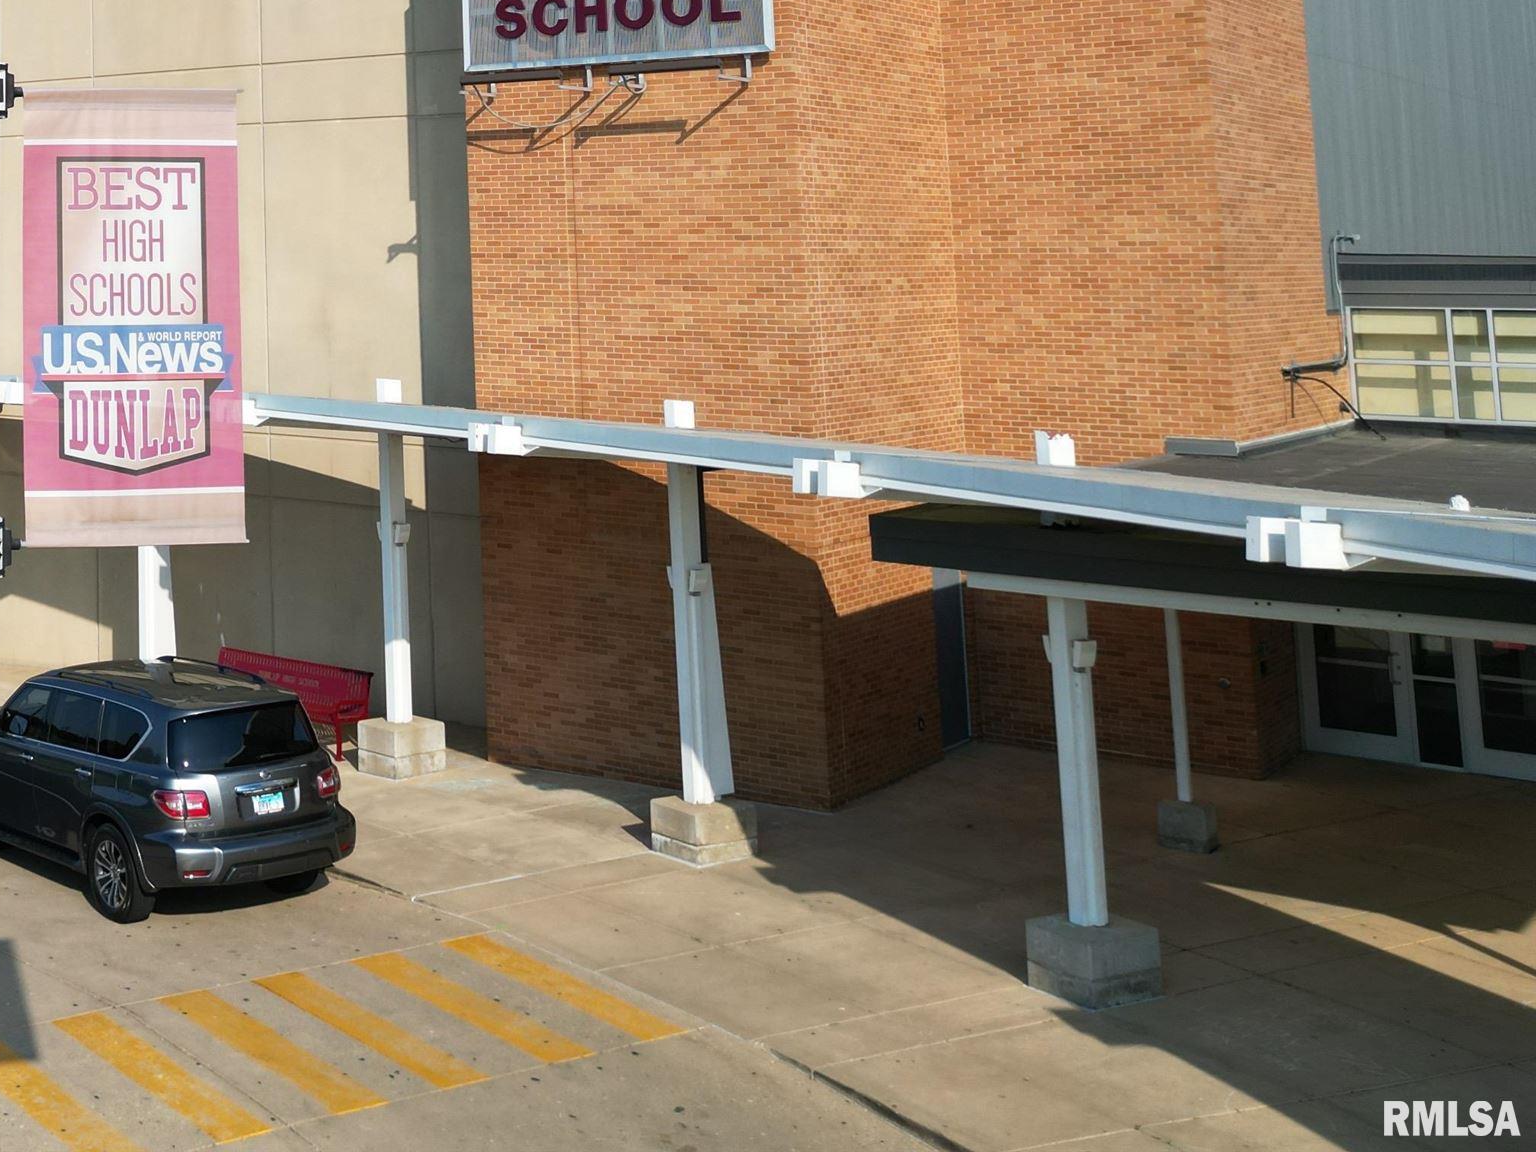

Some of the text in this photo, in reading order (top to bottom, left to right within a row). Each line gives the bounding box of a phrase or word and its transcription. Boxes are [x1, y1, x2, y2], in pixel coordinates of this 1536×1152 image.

[67, 166, 196, 211] BEST
[102, 219, 164, 262] HIGH
[69, 272, 197, 317] SCHOOLS
[137, 330, 222, 342] & WORLD REPORT
[68, 388, 201, 460] DUNLAP
